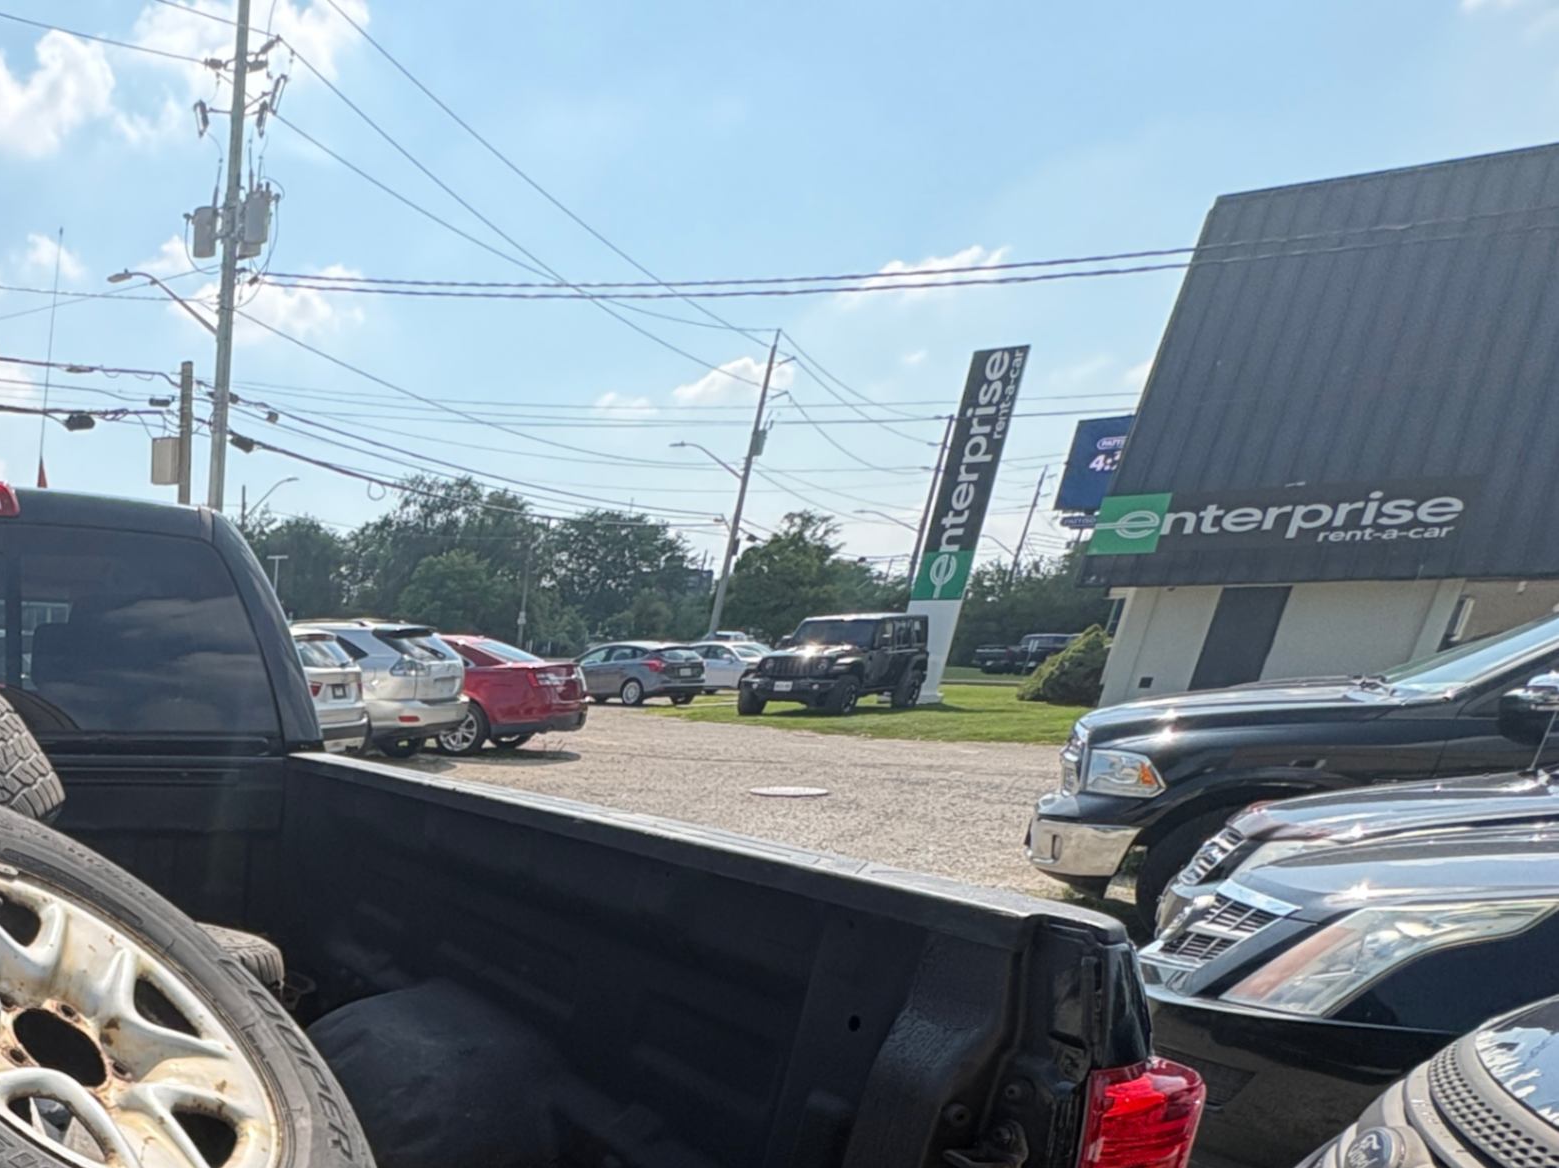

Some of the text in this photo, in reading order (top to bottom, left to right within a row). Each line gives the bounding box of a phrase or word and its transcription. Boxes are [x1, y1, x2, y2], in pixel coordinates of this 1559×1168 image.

[993, 349, 1024, 440] rent-a-car
[929, 350, 1010, 599] enterprise
[1096, 491, 1464, 539] enterprise
[1317, 525, 1455, 543] rent-a-car
[218, 958, 353, 1162] COOPER
